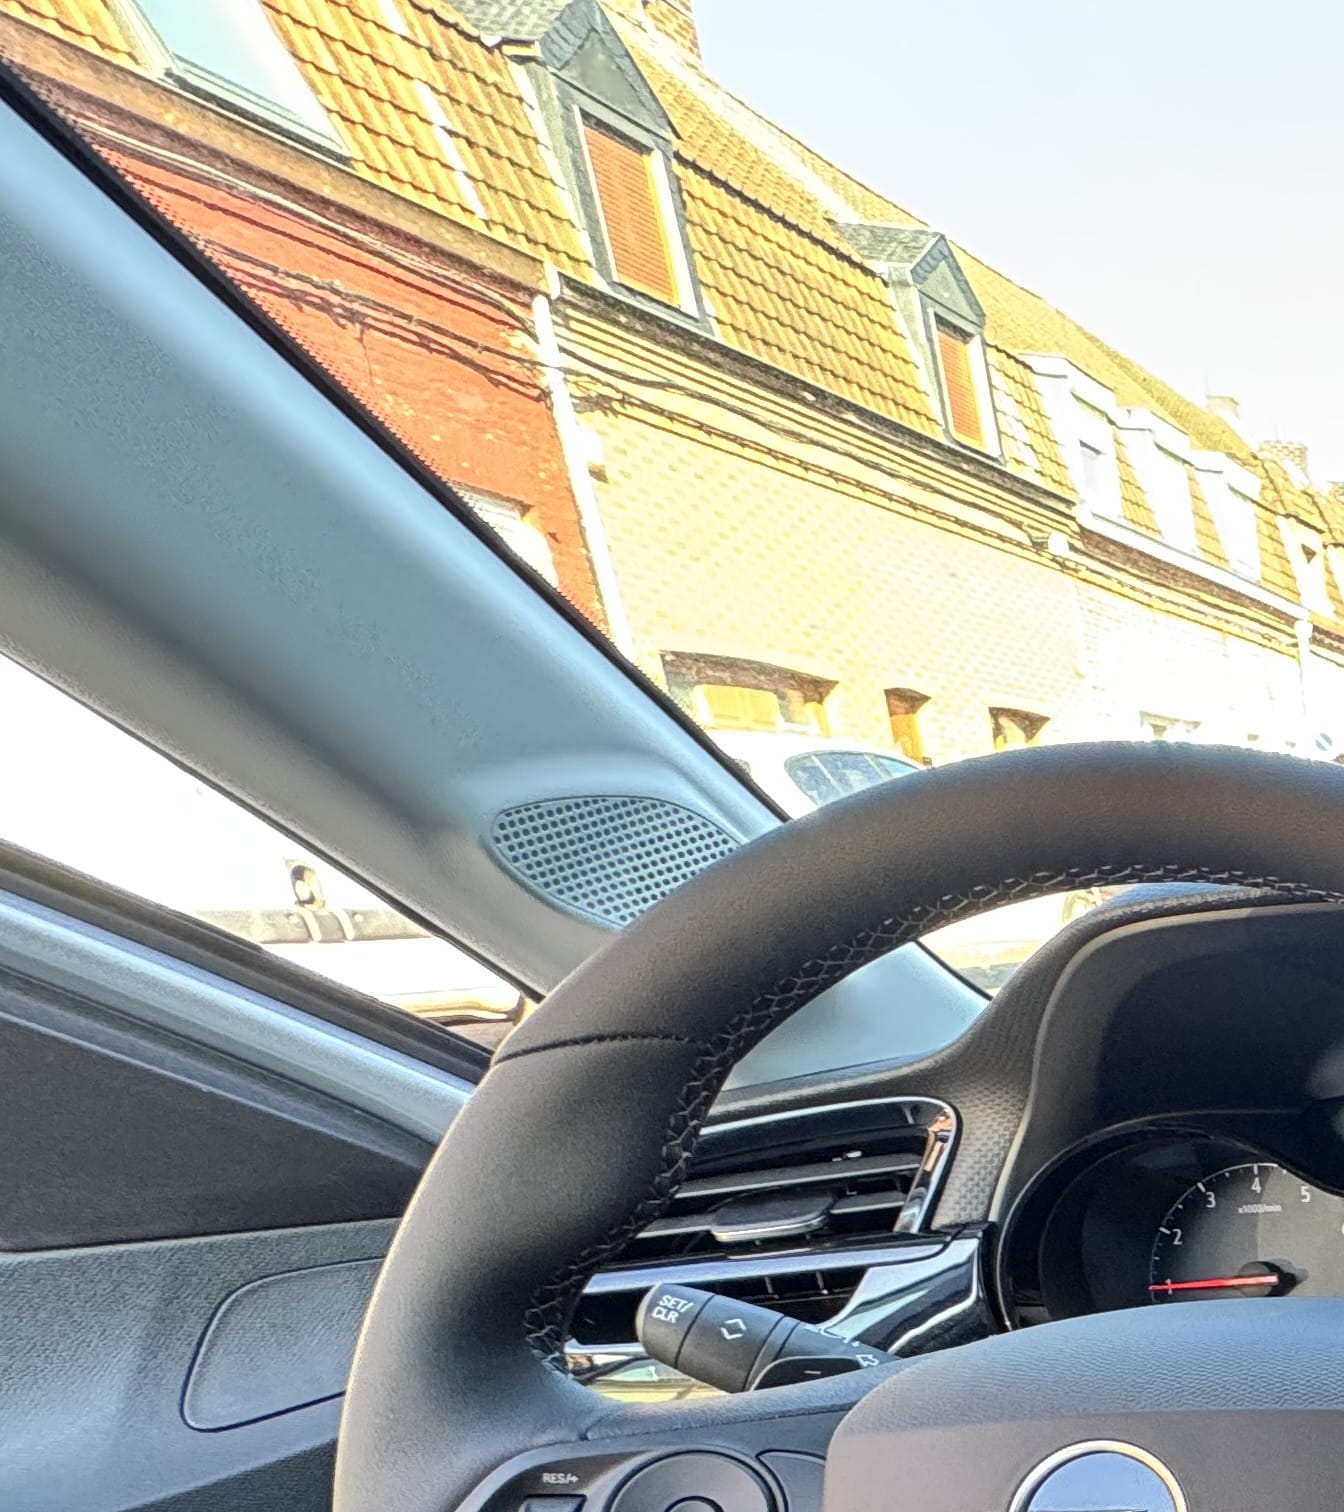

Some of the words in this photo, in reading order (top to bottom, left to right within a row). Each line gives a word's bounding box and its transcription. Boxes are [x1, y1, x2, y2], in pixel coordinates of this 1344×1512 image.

[1251, 1178, 1262, 1194] 4
[1206, 1192, 1217, 1208] 3
[1300, 1187, 1311, 1203] 5
[1172, 1229, 1183, 1245] 2
[659, 1295, 695, 1312] SET/
